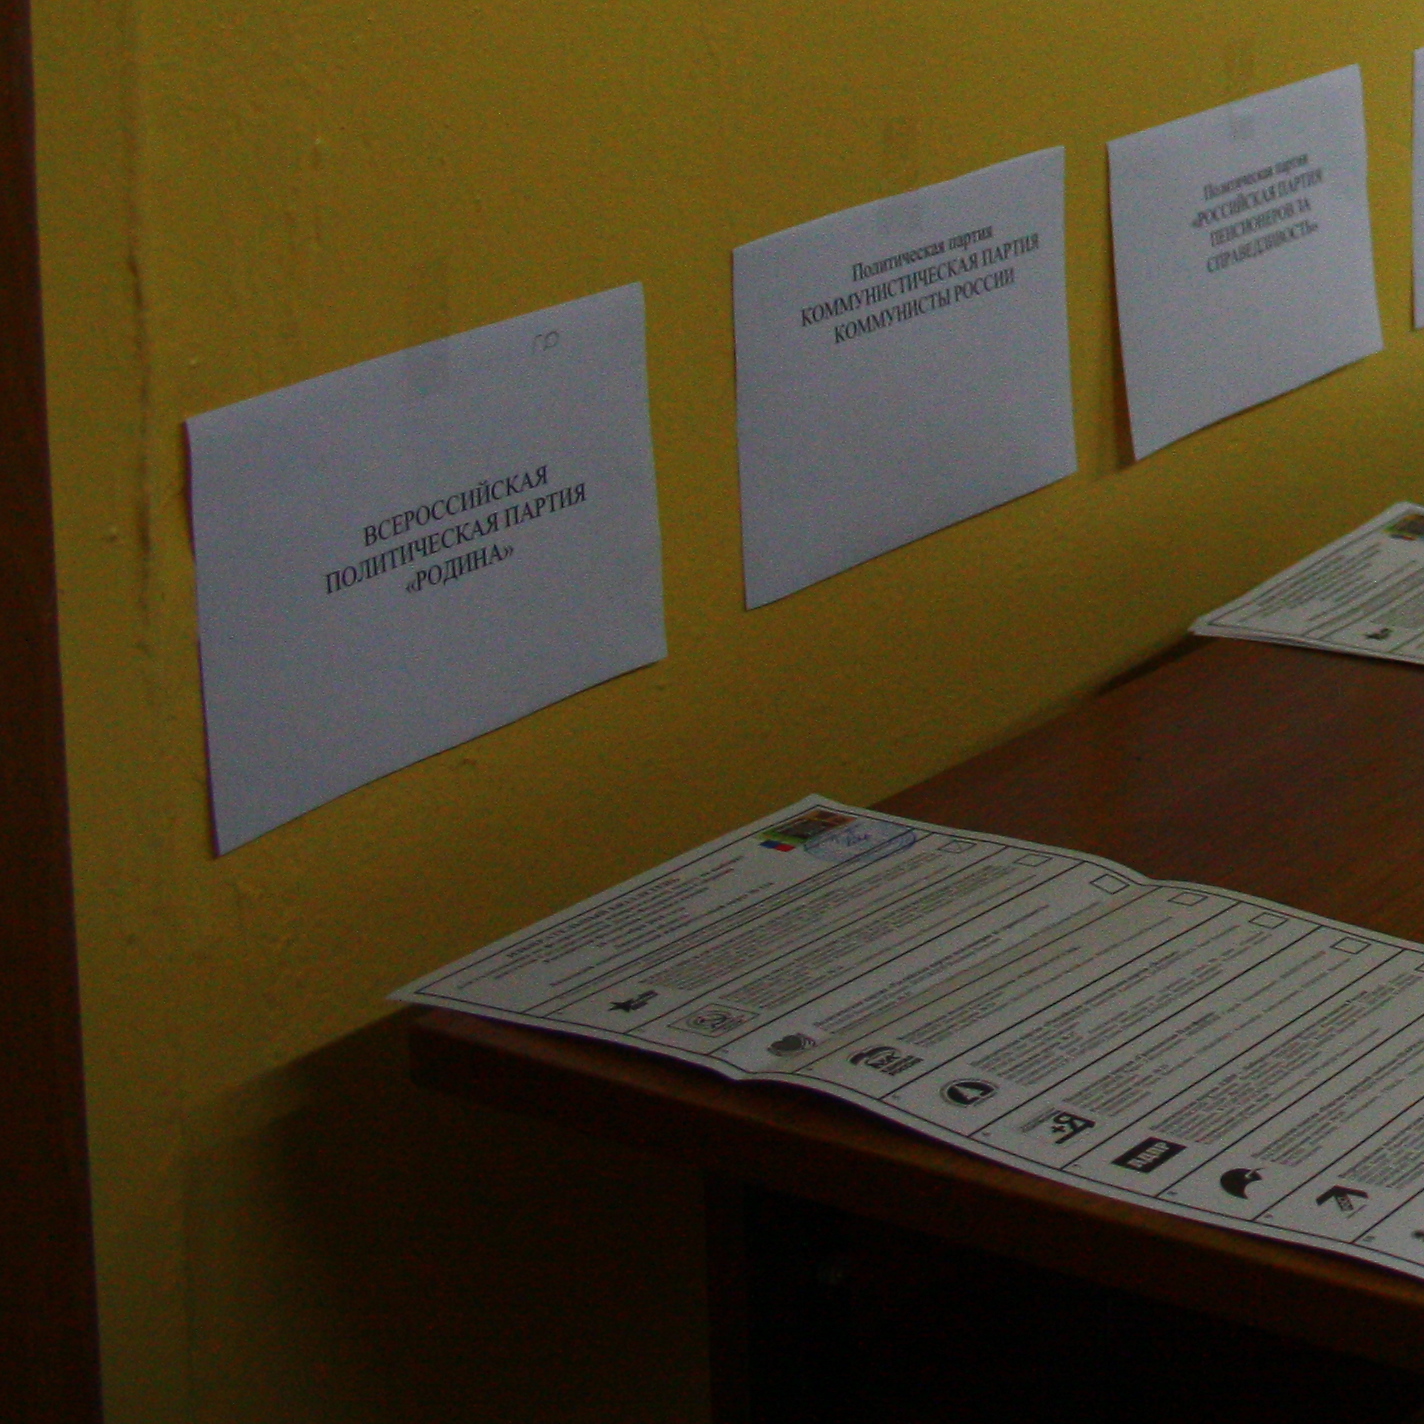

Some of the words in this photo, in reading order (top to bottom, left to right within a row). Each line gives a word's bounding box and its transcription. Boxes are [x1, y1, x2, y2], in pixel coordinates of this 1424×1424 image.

[800, 253, 979, 327] КОММУНИСТИЧЕСКАЯ
[981, 233, 1041, 266] ПАРТИЯ
[852, 241, 945, 282] Политическая
[948, 226, 993, 252] партия
[833, 288, 951, 345] КОММУНИСТЫ
[953, 268, 1016, 303] РОССИИ
[325, 511, 500, 594] ПОЛИТИЧЕСКАЯ
[504, 482, 588, 528] ПАРТИЯ
[363, 464, 549, 547] ВСЕРОССИЙСКАЯ
[405, 542, 515, 593] «РОДИНА»
